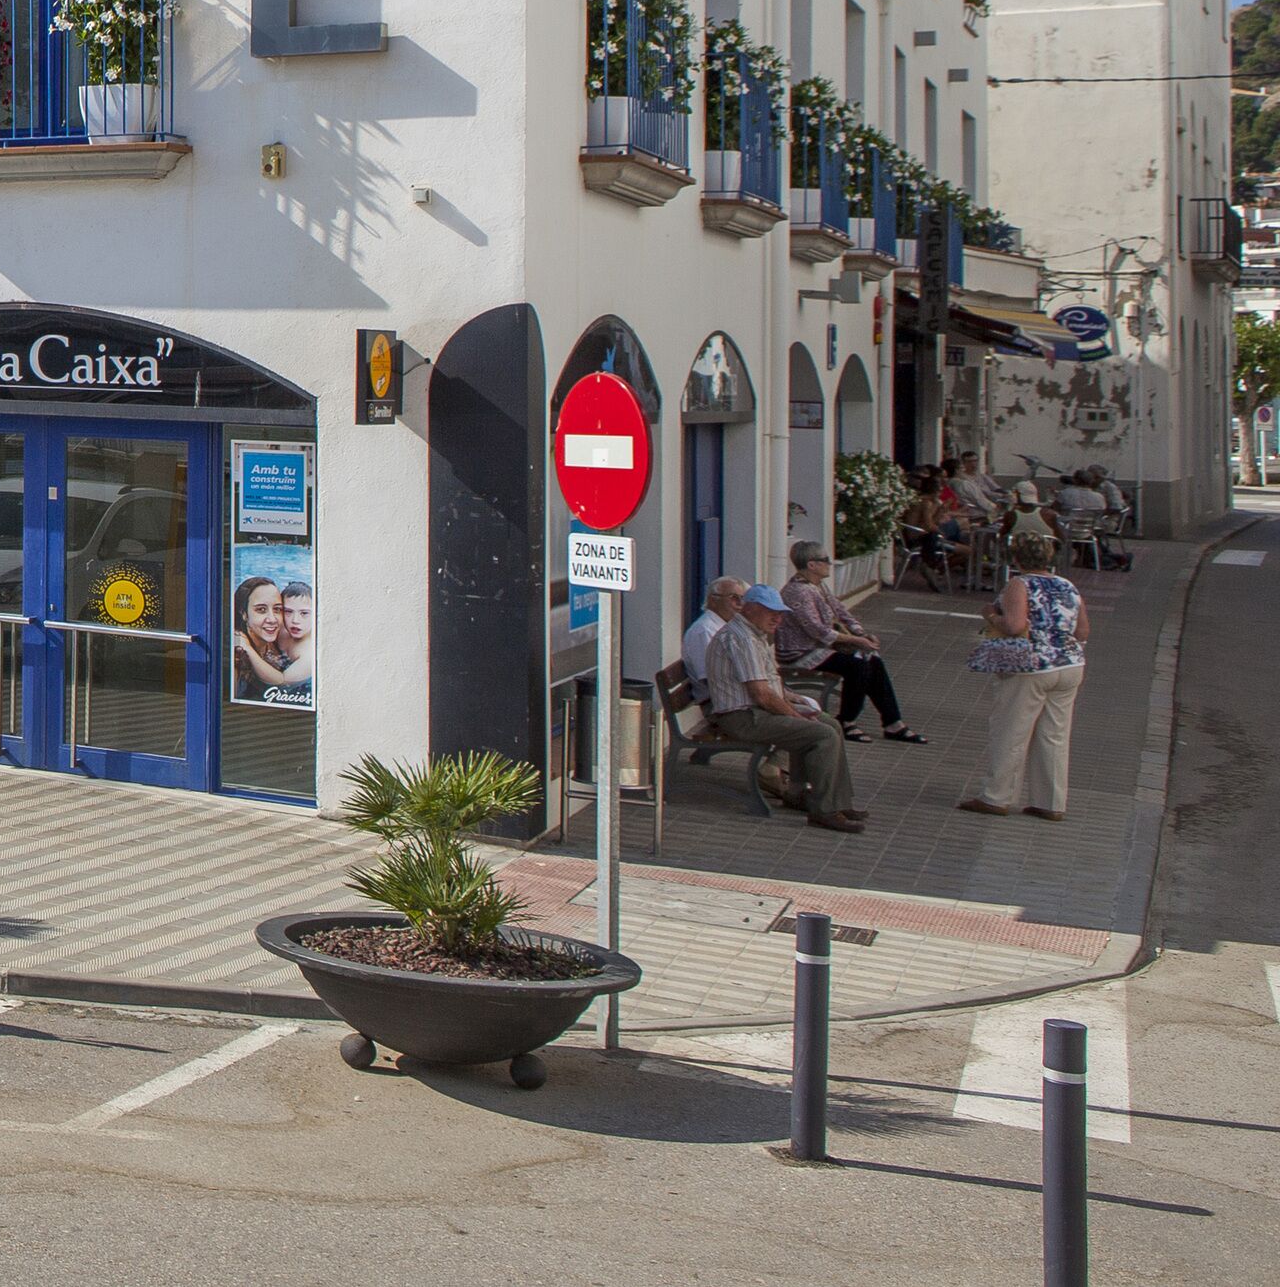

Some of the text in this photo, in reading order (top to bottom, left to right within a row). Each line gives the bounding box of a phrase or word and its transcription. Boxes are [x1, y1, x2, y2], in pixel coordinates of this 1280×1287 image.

[251, 464, 297, 476] Amb tu
[575, 542, 625, 561] ZONA DE
[572, 562, 629, 583] VIANANTS
[112, 602, 136, 610] inside
[263, 686, 312, 704] Gràcies
